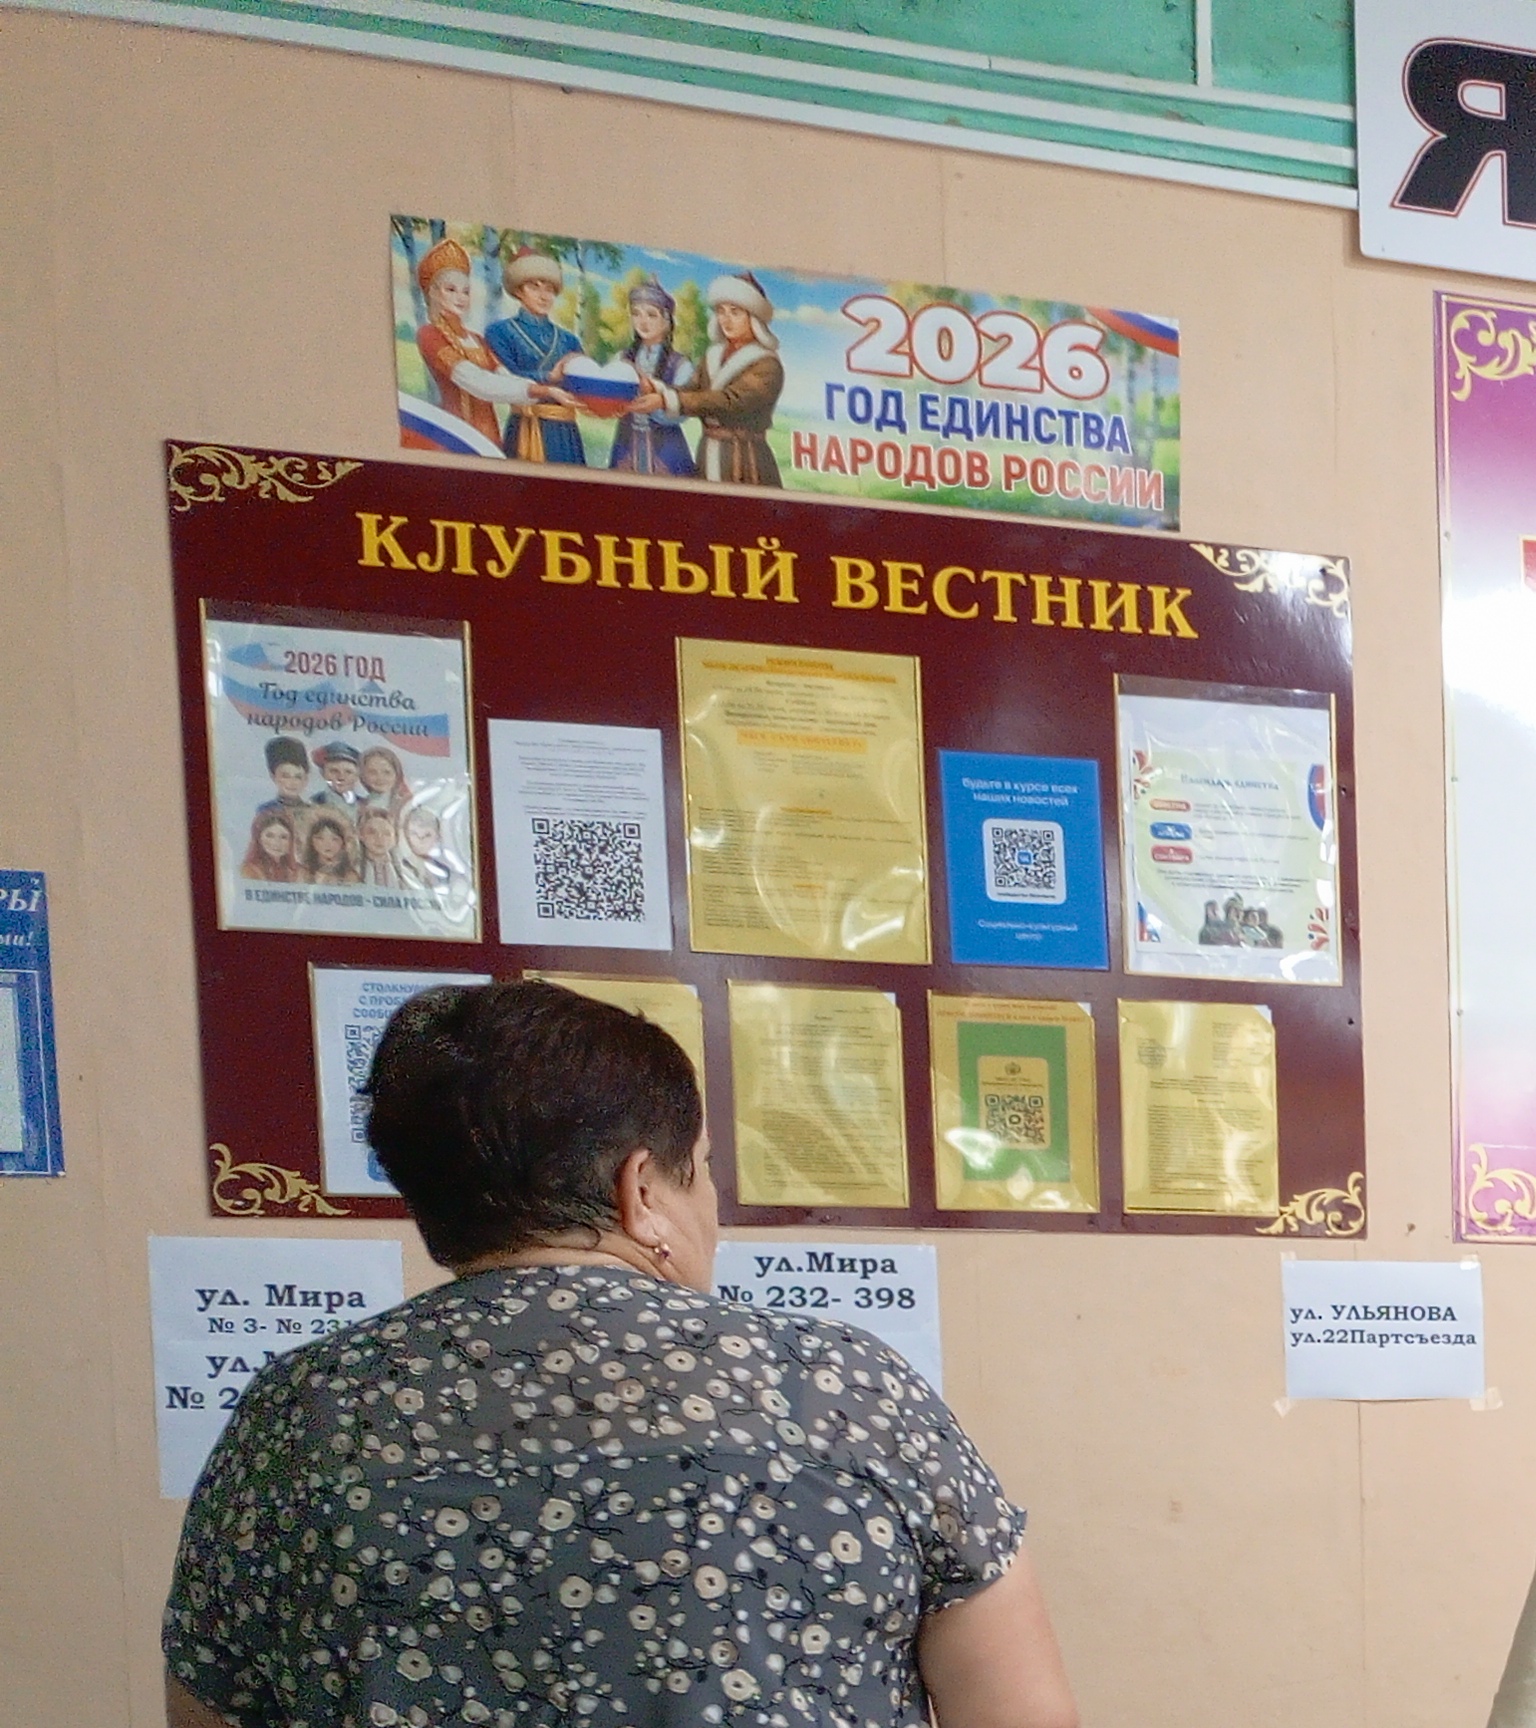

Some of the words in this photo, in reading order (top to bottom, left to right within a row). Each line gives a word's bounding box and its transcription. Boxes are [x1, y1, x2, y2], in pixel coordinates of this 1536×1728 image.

[844, 295, 1110, 399] 2026
[824, 381, 907, 434] ГОД
[919, 394, 1132, 455] ЕДИНСТВА
[792, 431, 992, 491] НАРОДОВ
[1003, 455, 1164, 511] РОССИИ
[358, 513, 799, 603] КЛУБНЫЙ
[832, 558, 1200, 640] ВЕСТНИК
[284, 651, 337, 676] 2026
[344, 655, 386, 683] ГОД
[259, 683, 297, 706] Год
[305, 690, 415, 710] единства
[248, 713, 343, 735] народов
[353, 715, 428, 737] России
[755, 1252, 898, 1278] ул.Мира
[195, 1288, 249, 1312] ул.
[265, 1284, 366, 1313] Мира
[720, 1285, 753, 1304] №
[767, 1285, 842, 1309] 232-
[855, 1287, 916, 1310] 398
[208, 1318, 234, 1333] №
[243, 1318, 266, 1333] 3-
[277, 1319, 301, 1334] №
[1290, 1307, 1322, 1323] ул.
[1331, 1306, 1457, 1323] УЛЬЯНОВА
[1290, 1329, 1477, 1348] ул.22Партсъезда
[166, 1386, 204, 1409] №
